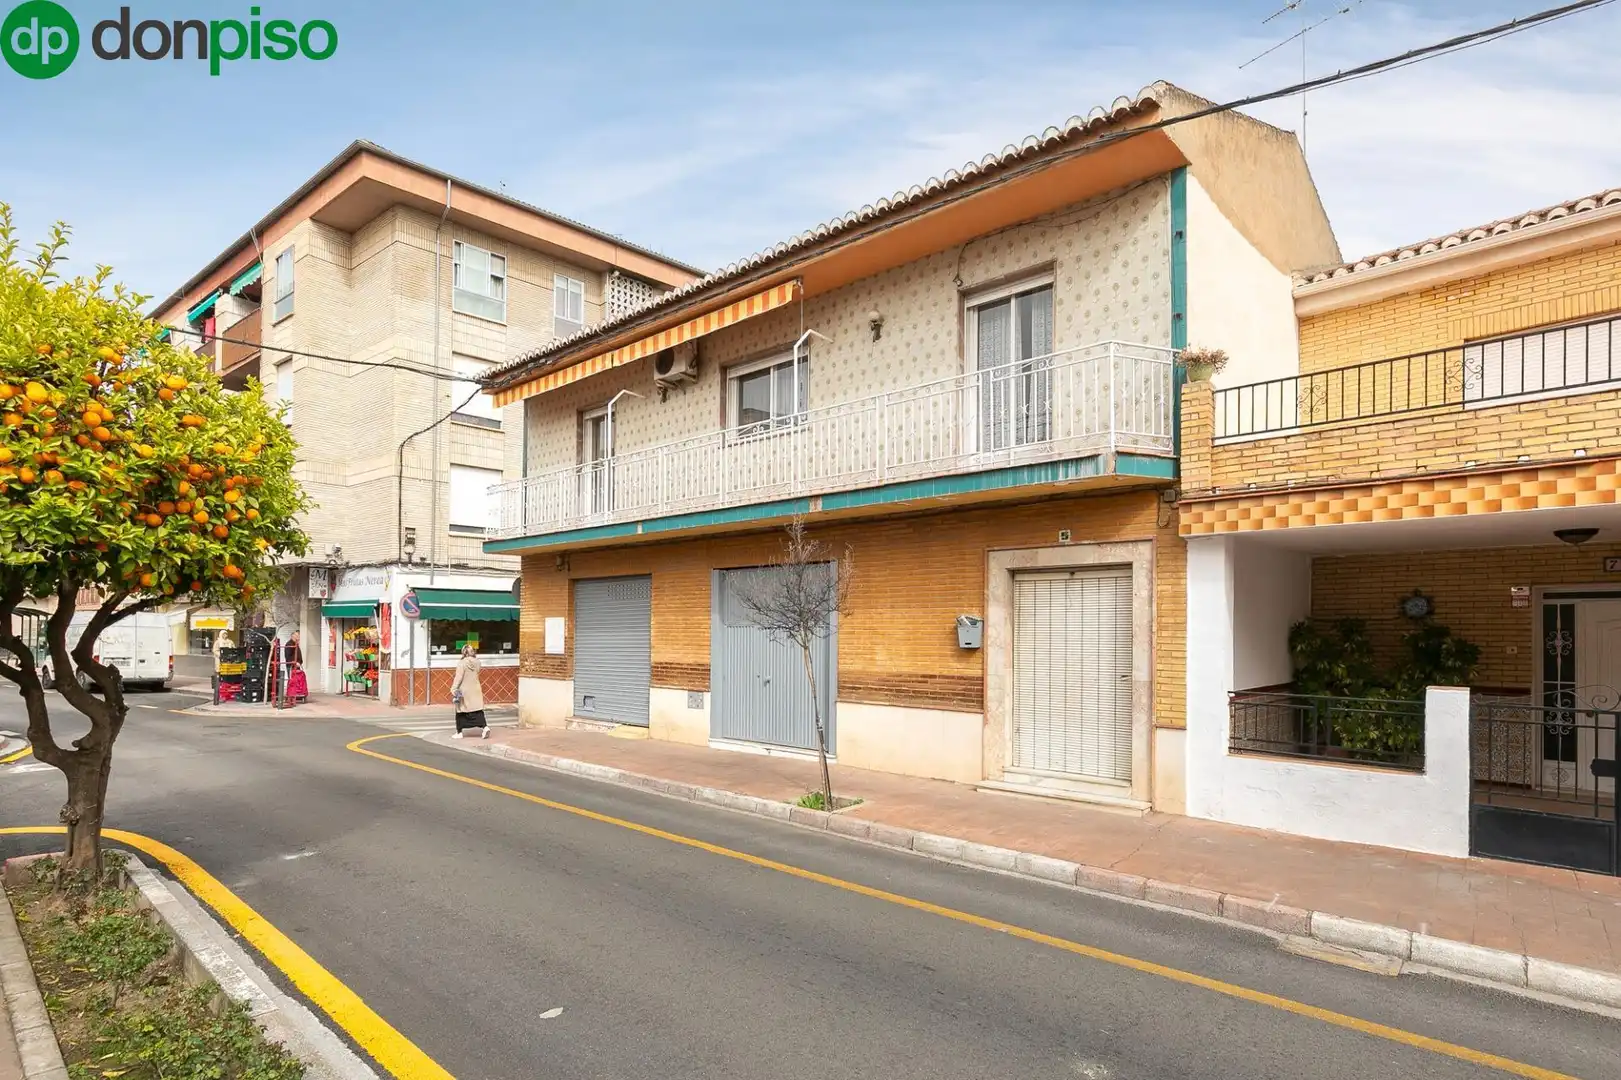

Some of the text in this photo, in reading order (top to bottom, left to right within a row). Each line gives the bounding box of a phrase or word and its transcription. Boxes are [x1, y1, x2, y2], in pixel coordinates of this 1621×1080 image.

[1060, 531, 1069, 541] 5
[1610, 560, 1618, 570] 7
[364, 575, 384, 586] Nerea
